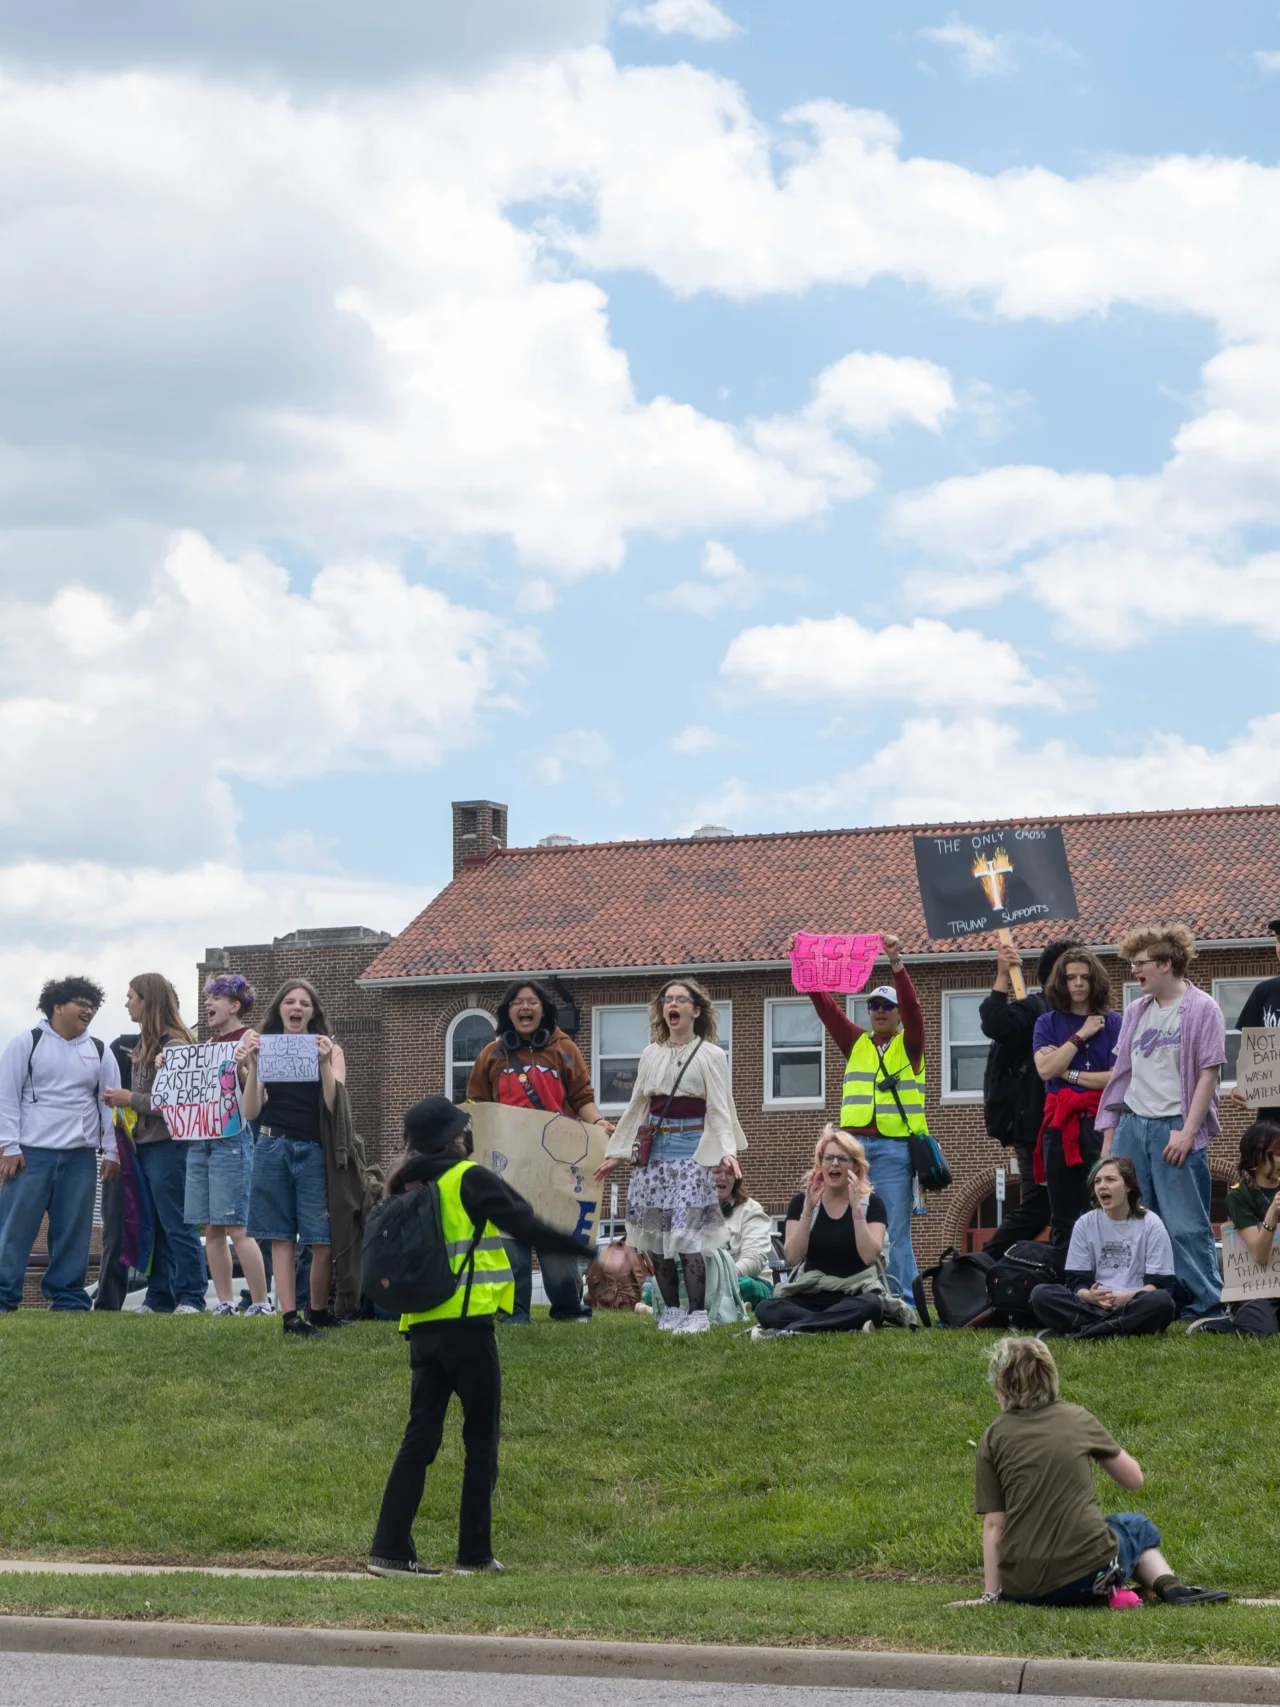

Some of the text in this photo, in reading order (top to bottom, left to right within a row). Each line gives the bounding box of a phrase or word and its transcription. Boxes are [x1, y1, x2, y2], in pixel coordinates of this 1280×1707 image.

[933, 829, 1047, 855] THE ONLY CROSS
[946, 904, 1050, 935] TRUMP SUPPORTS
[794, 936, 878, 960] ICE
[798, 961, 866, 988] OUT
[259, 1036, 298, 1058] ICE
[1246, 1033, 1276, 1051] NOT
[162, 1041, 240, 1071] RESPECT MY
[258, 1057, 319, 1079] LIBERTY
[155, 1067, 219, 1092] EXISTENCE
[1245, 1069, 1274, 1083] WASNT
[152, 1085, 217, 1107] OR EXPECT
[152, 1101, 222, 1139] SISTANCE
[1234, 1263, 1268, 1278] THAN
